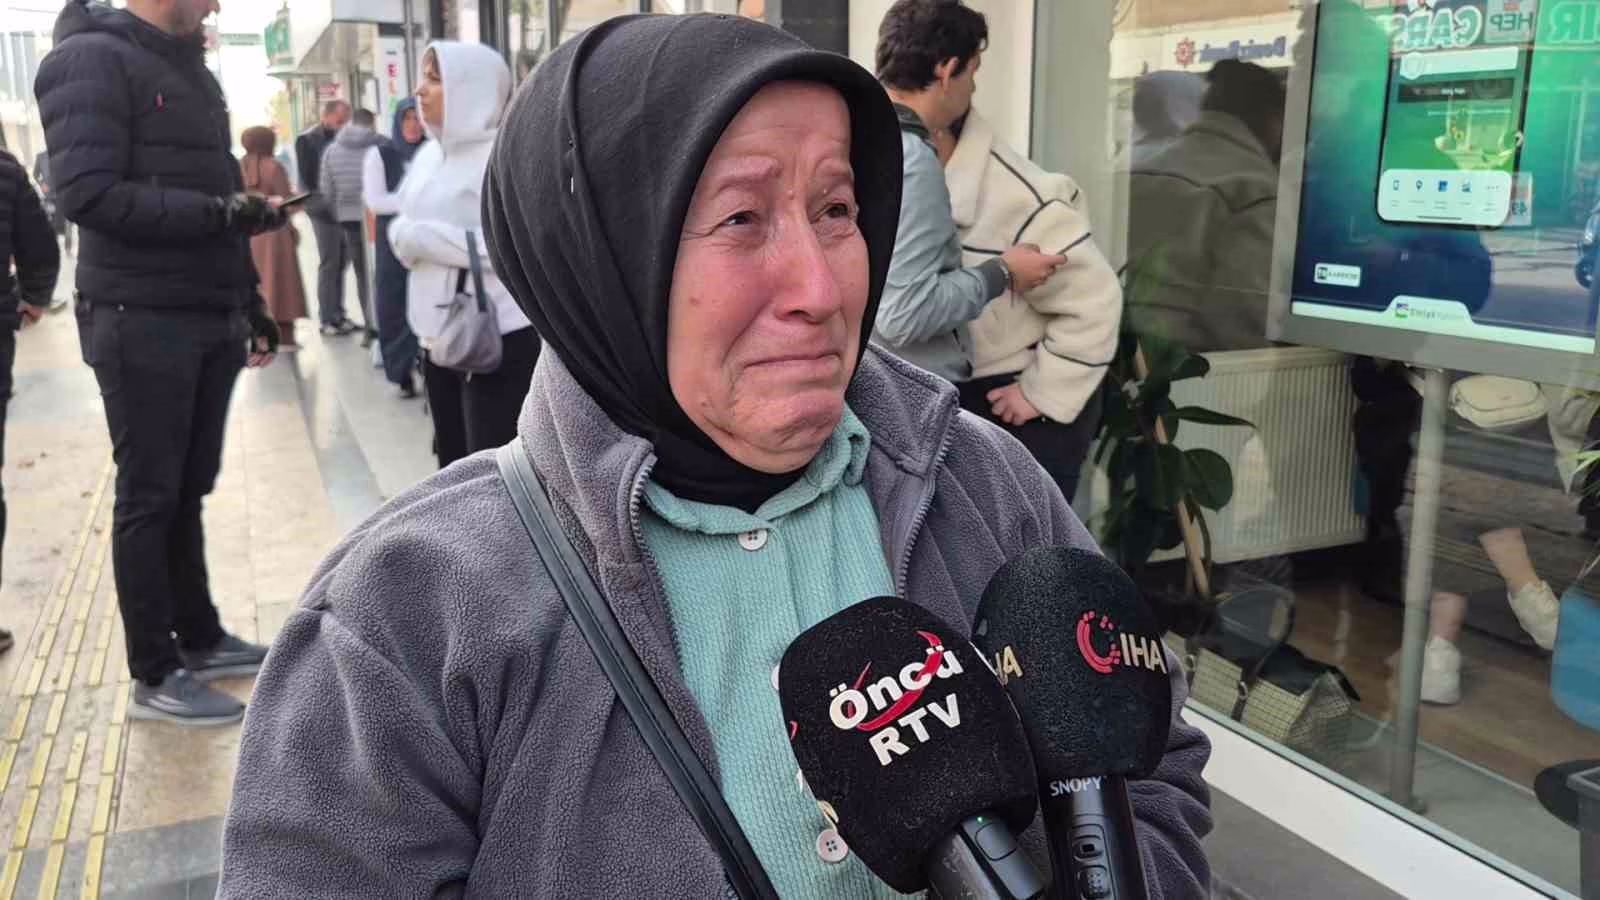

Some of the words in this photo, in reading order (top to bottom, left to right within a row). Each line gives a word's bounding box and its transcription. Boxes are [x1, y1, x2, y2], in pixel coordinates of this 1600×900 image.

[829, 645, 964, 730] Öncü
[869, 693, 961, 766] RTV
[1049, 776, 1103, 797] SNOPY
